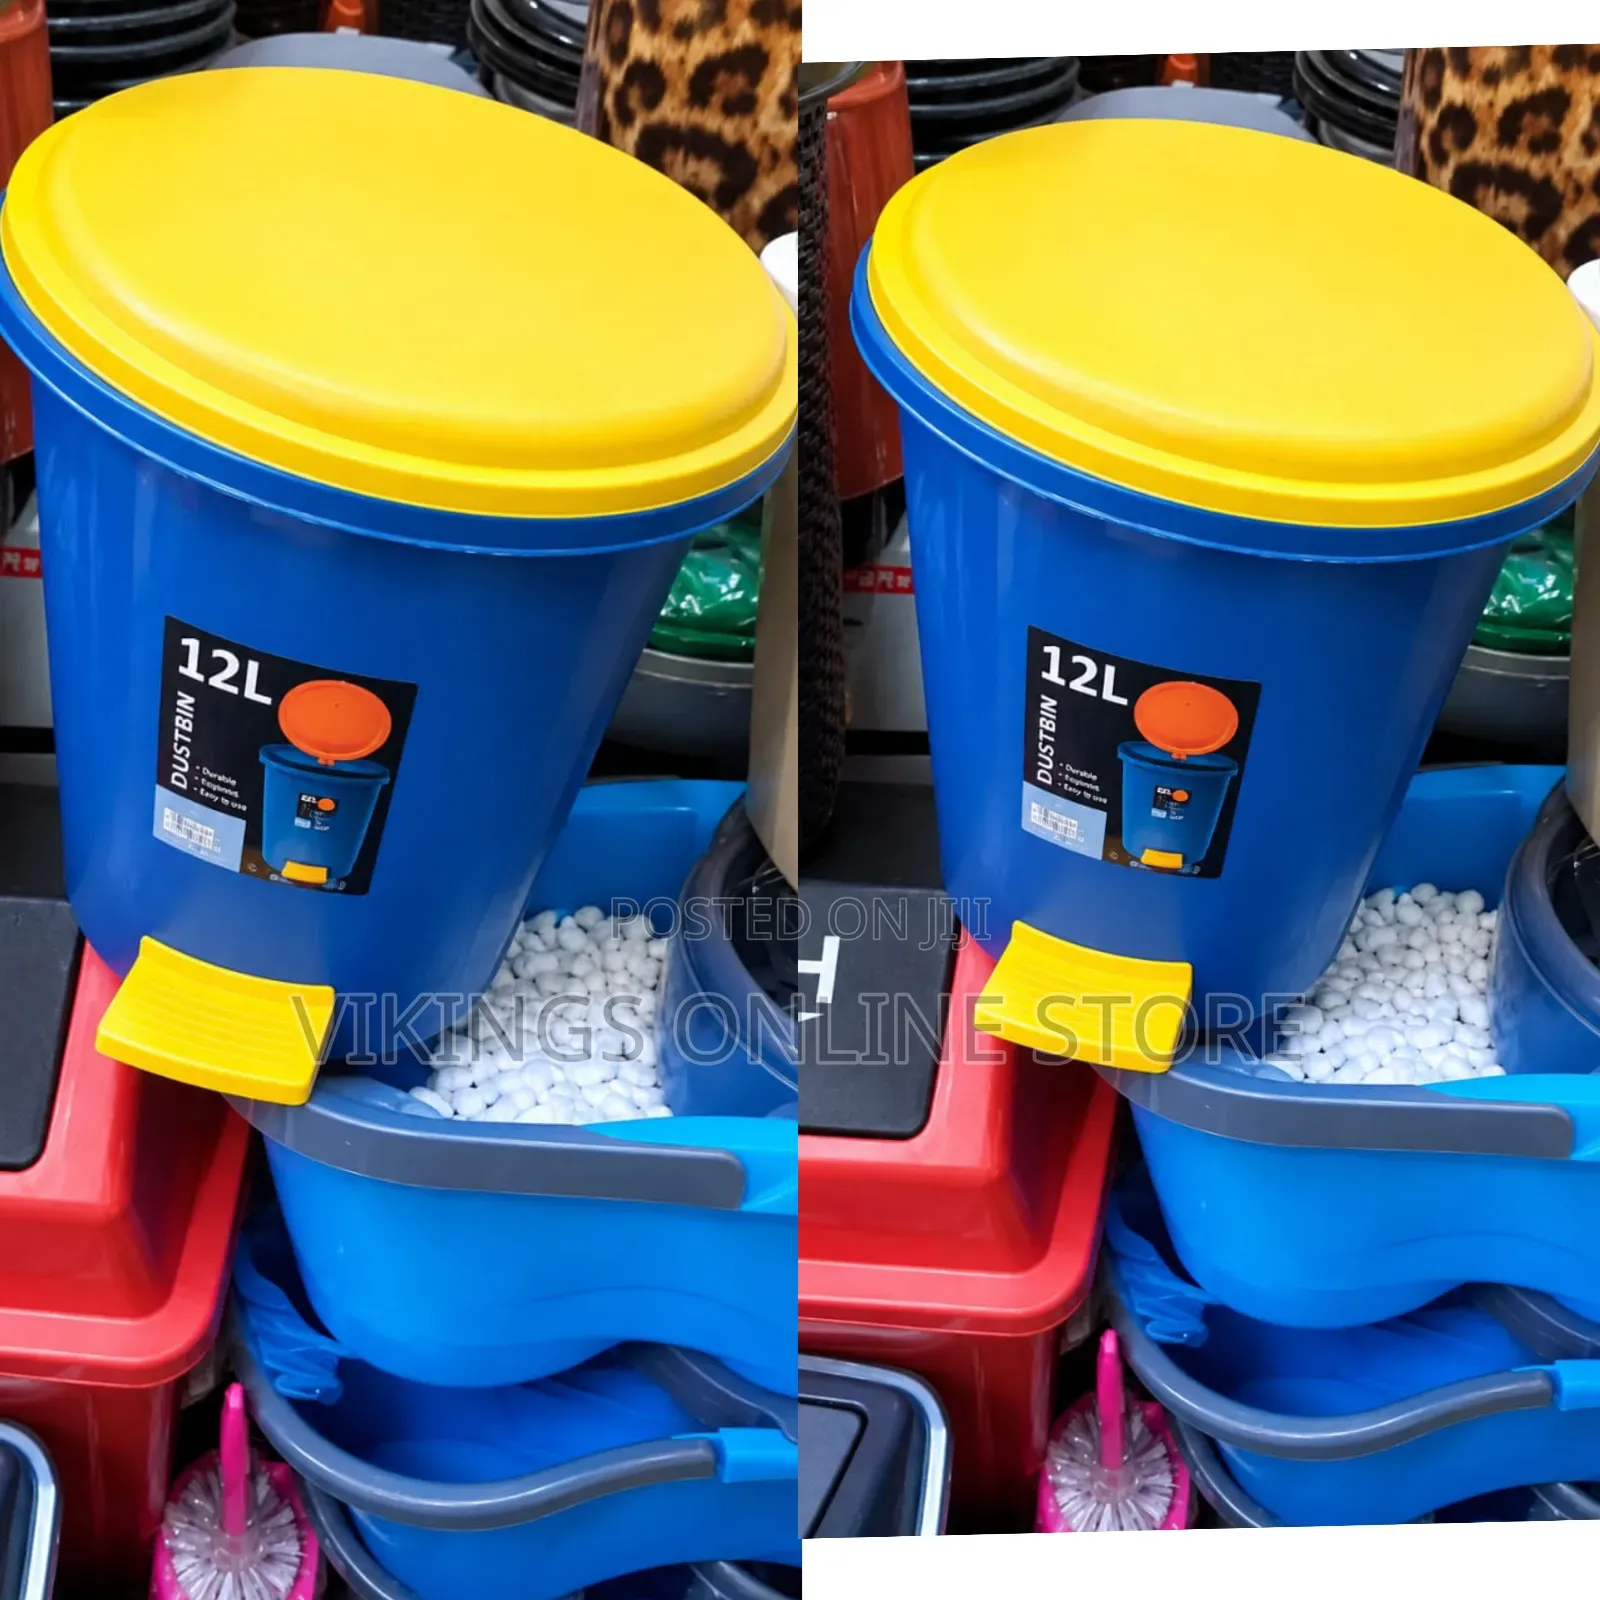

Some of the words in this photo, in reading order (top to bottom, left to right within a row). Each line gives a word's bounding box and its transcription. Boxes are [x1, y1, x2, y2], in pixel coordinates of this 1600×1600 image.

[178, 637, 273, 706] 12L
[1041, 645, 1129, 706] 12L
[171, 690, 196, 790] DUSTBIN
[1036, 695, 1058, 785] DUSTBIN
